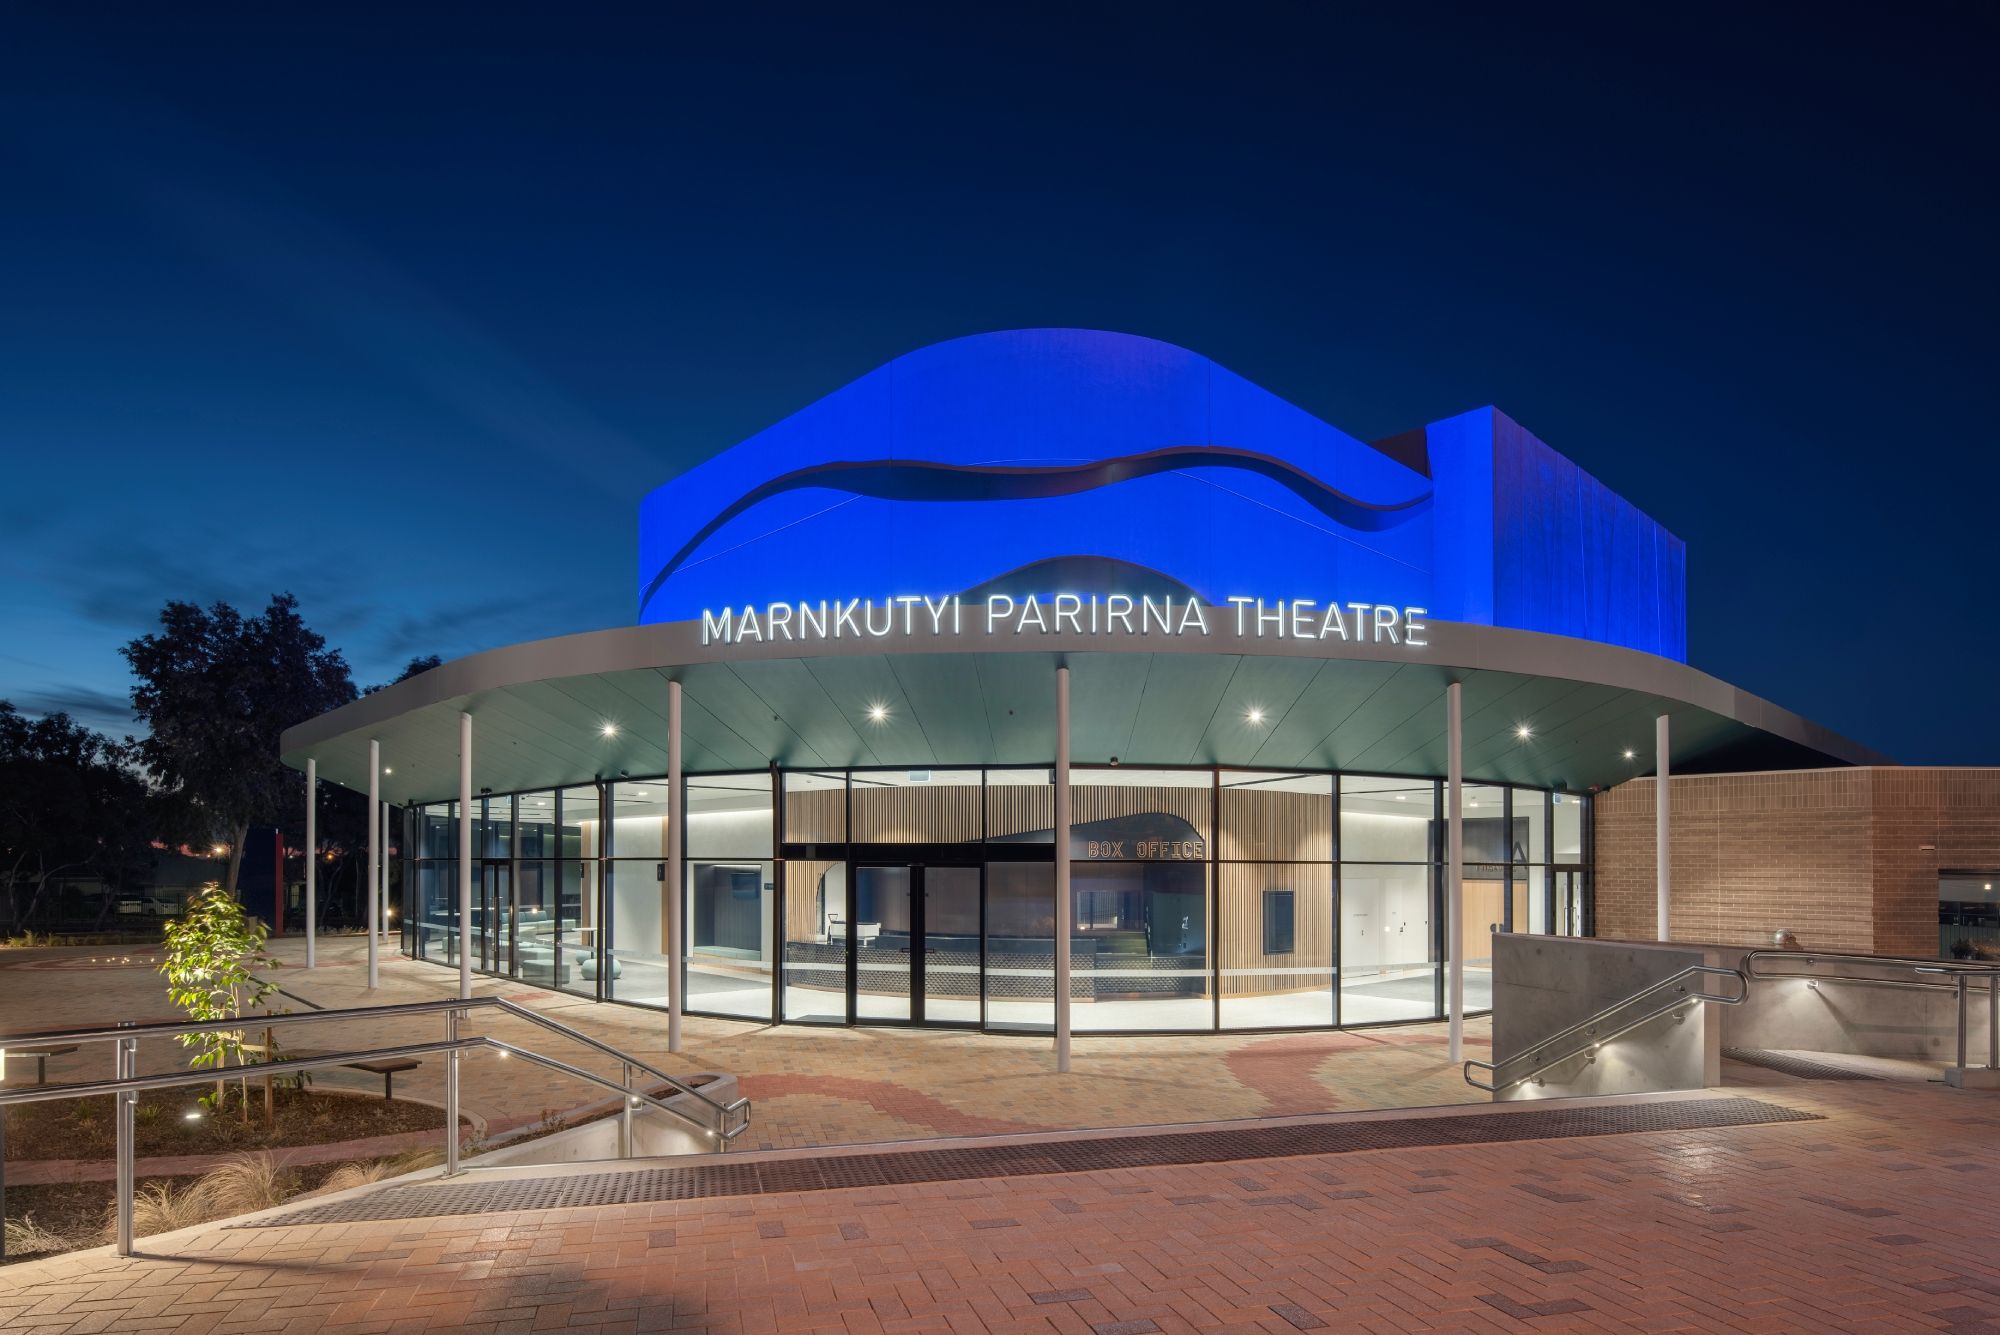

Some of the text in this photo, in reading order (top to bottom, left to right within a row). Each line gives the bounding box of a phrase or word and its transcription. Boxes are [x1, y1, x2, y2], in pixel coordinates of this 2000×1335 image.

[702, 593, 1428, 646] MARNKUTYI PARIRNA THEATRE
[1088, 840, 1203, 859] BOX OFFICE
